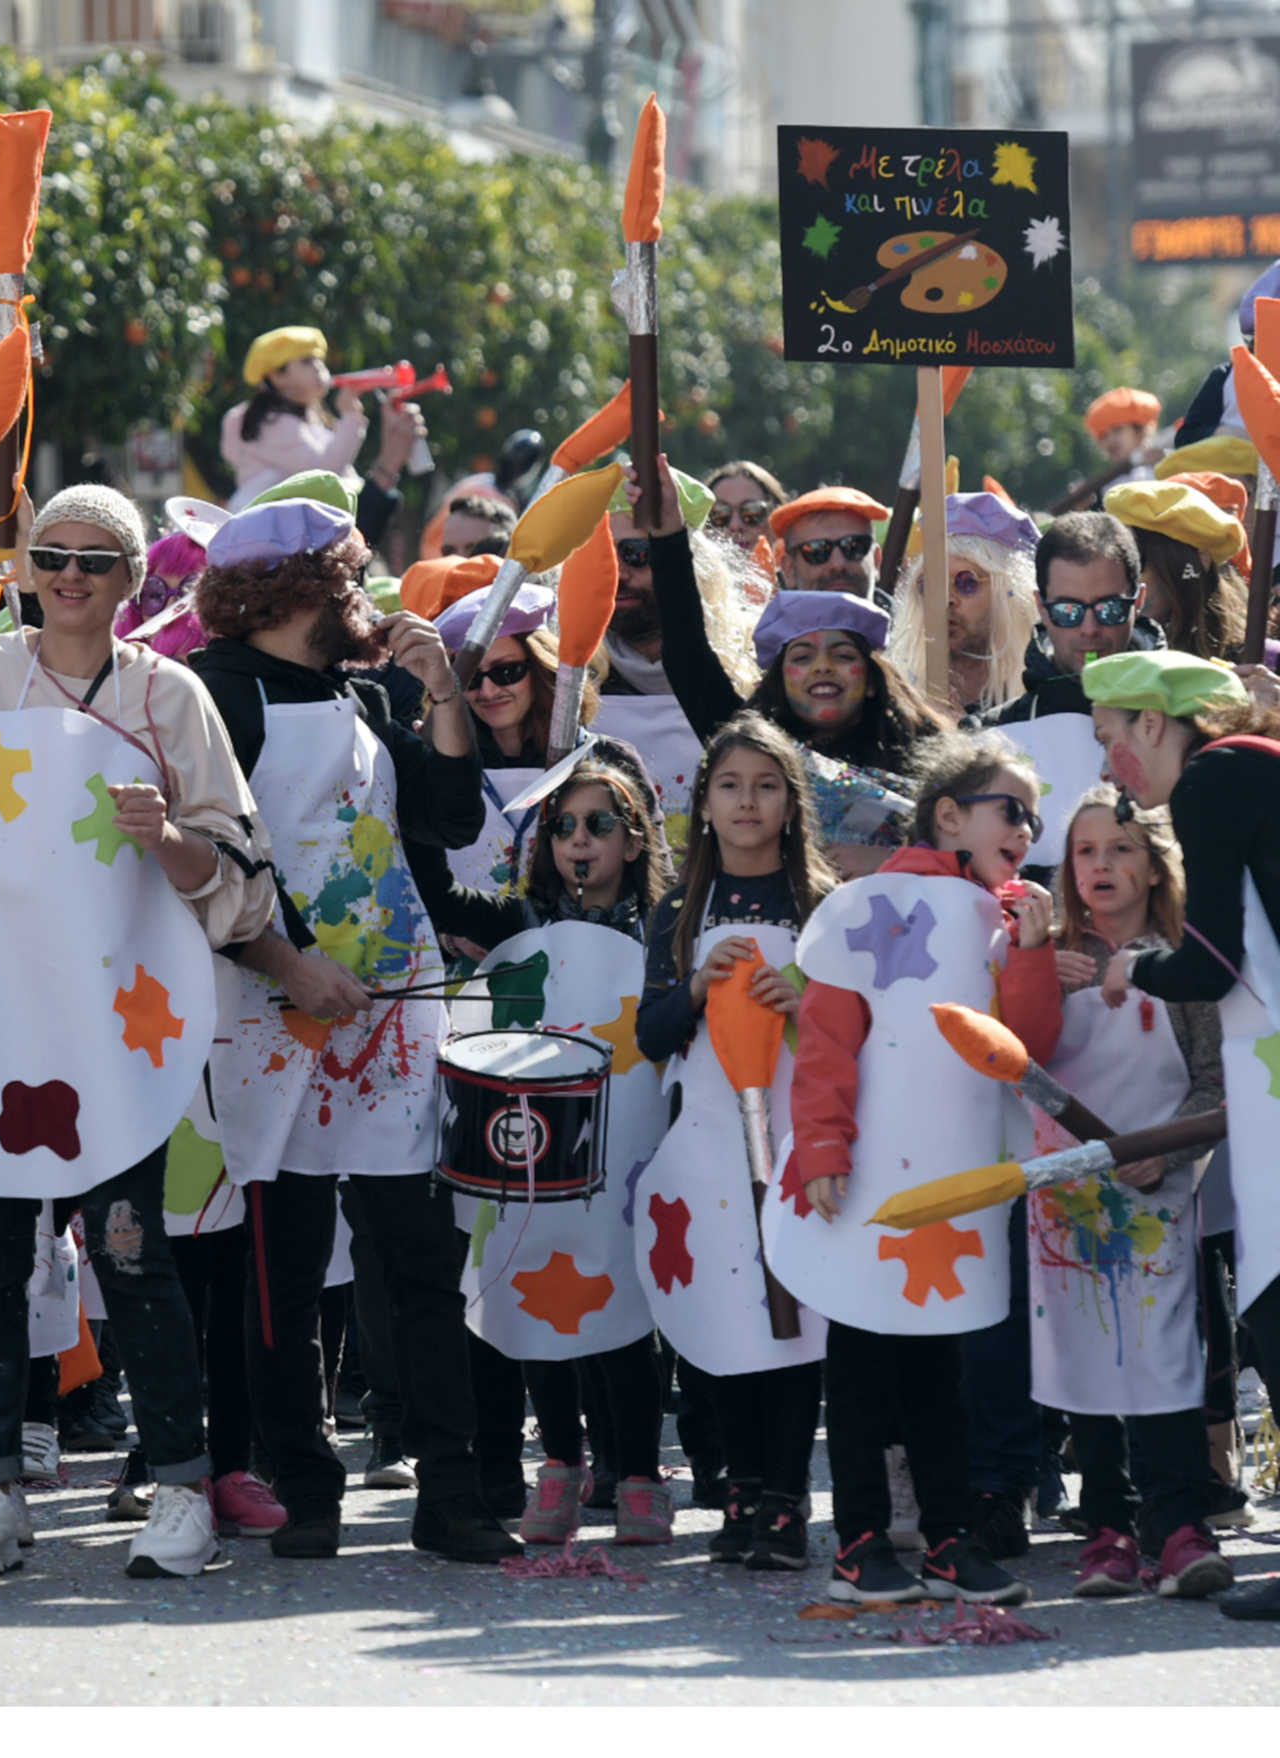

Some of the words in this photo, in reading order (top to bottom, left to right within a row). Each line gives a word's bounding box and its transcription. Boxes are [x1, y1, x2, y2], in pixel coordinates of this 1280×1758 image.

[849, 145, 895, 180] Με
[902, 147, 983, 187] τρέλα
[844, 193, 885, 215] και
[894, 188, 989, 220] πινέλα
[861, 328, 957, 360] Δημοτικό
[965, 327, 1056, 355] Μοσχάτου
